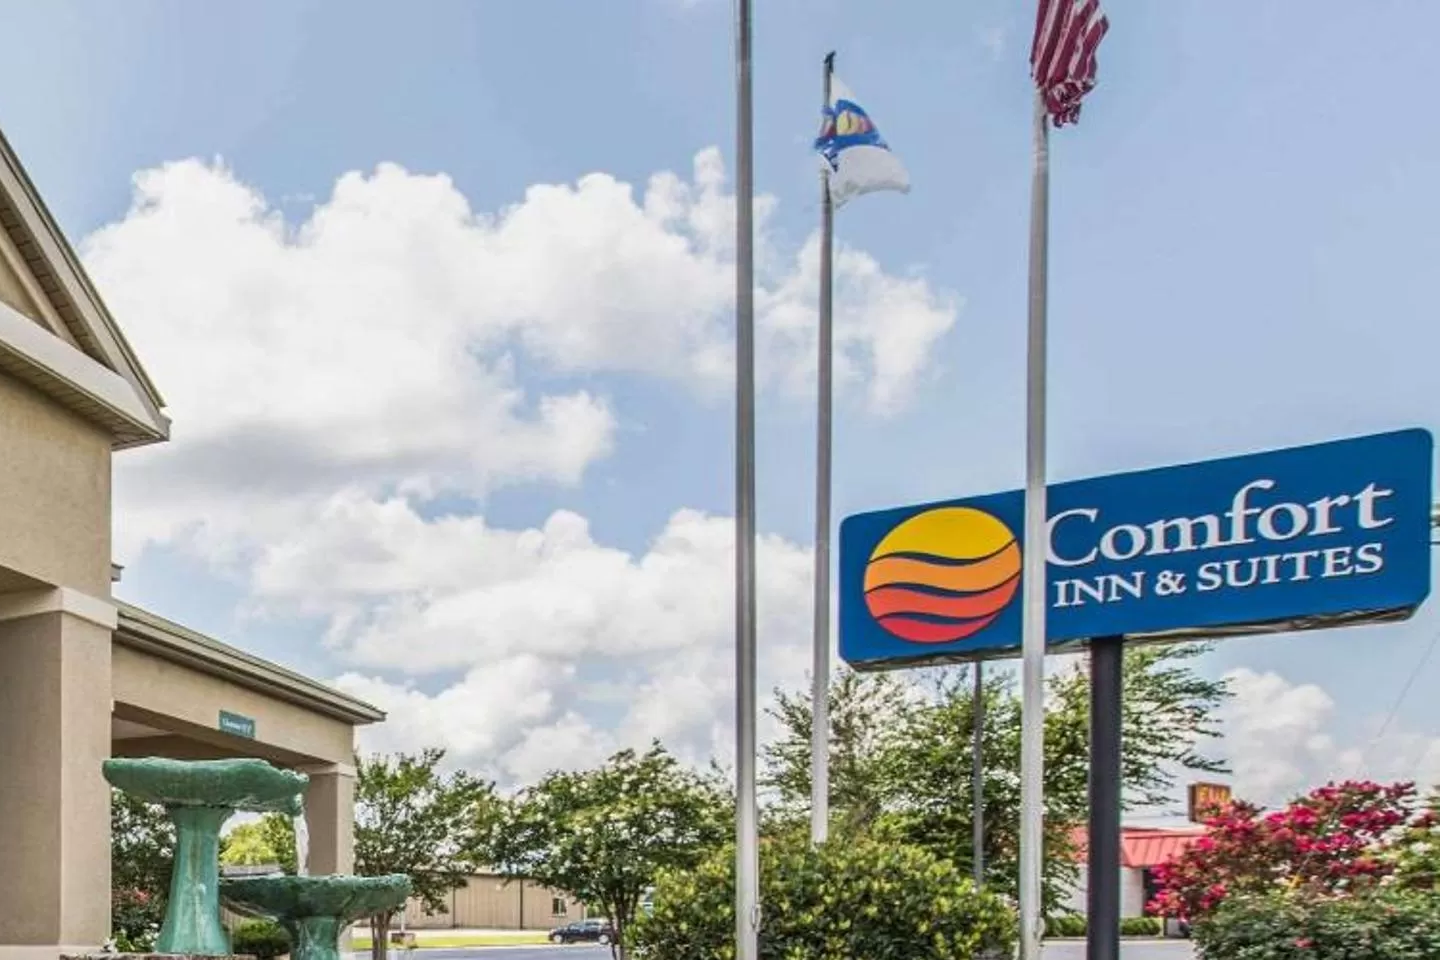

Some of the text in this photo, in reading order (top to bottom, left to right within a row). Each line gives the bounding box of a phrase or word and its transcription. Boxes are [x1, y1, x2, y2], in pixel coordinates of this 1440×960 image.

[1045, 478, 1395, 566] Comfort
[1052, 542, 1384, 608] INN & SUITES
